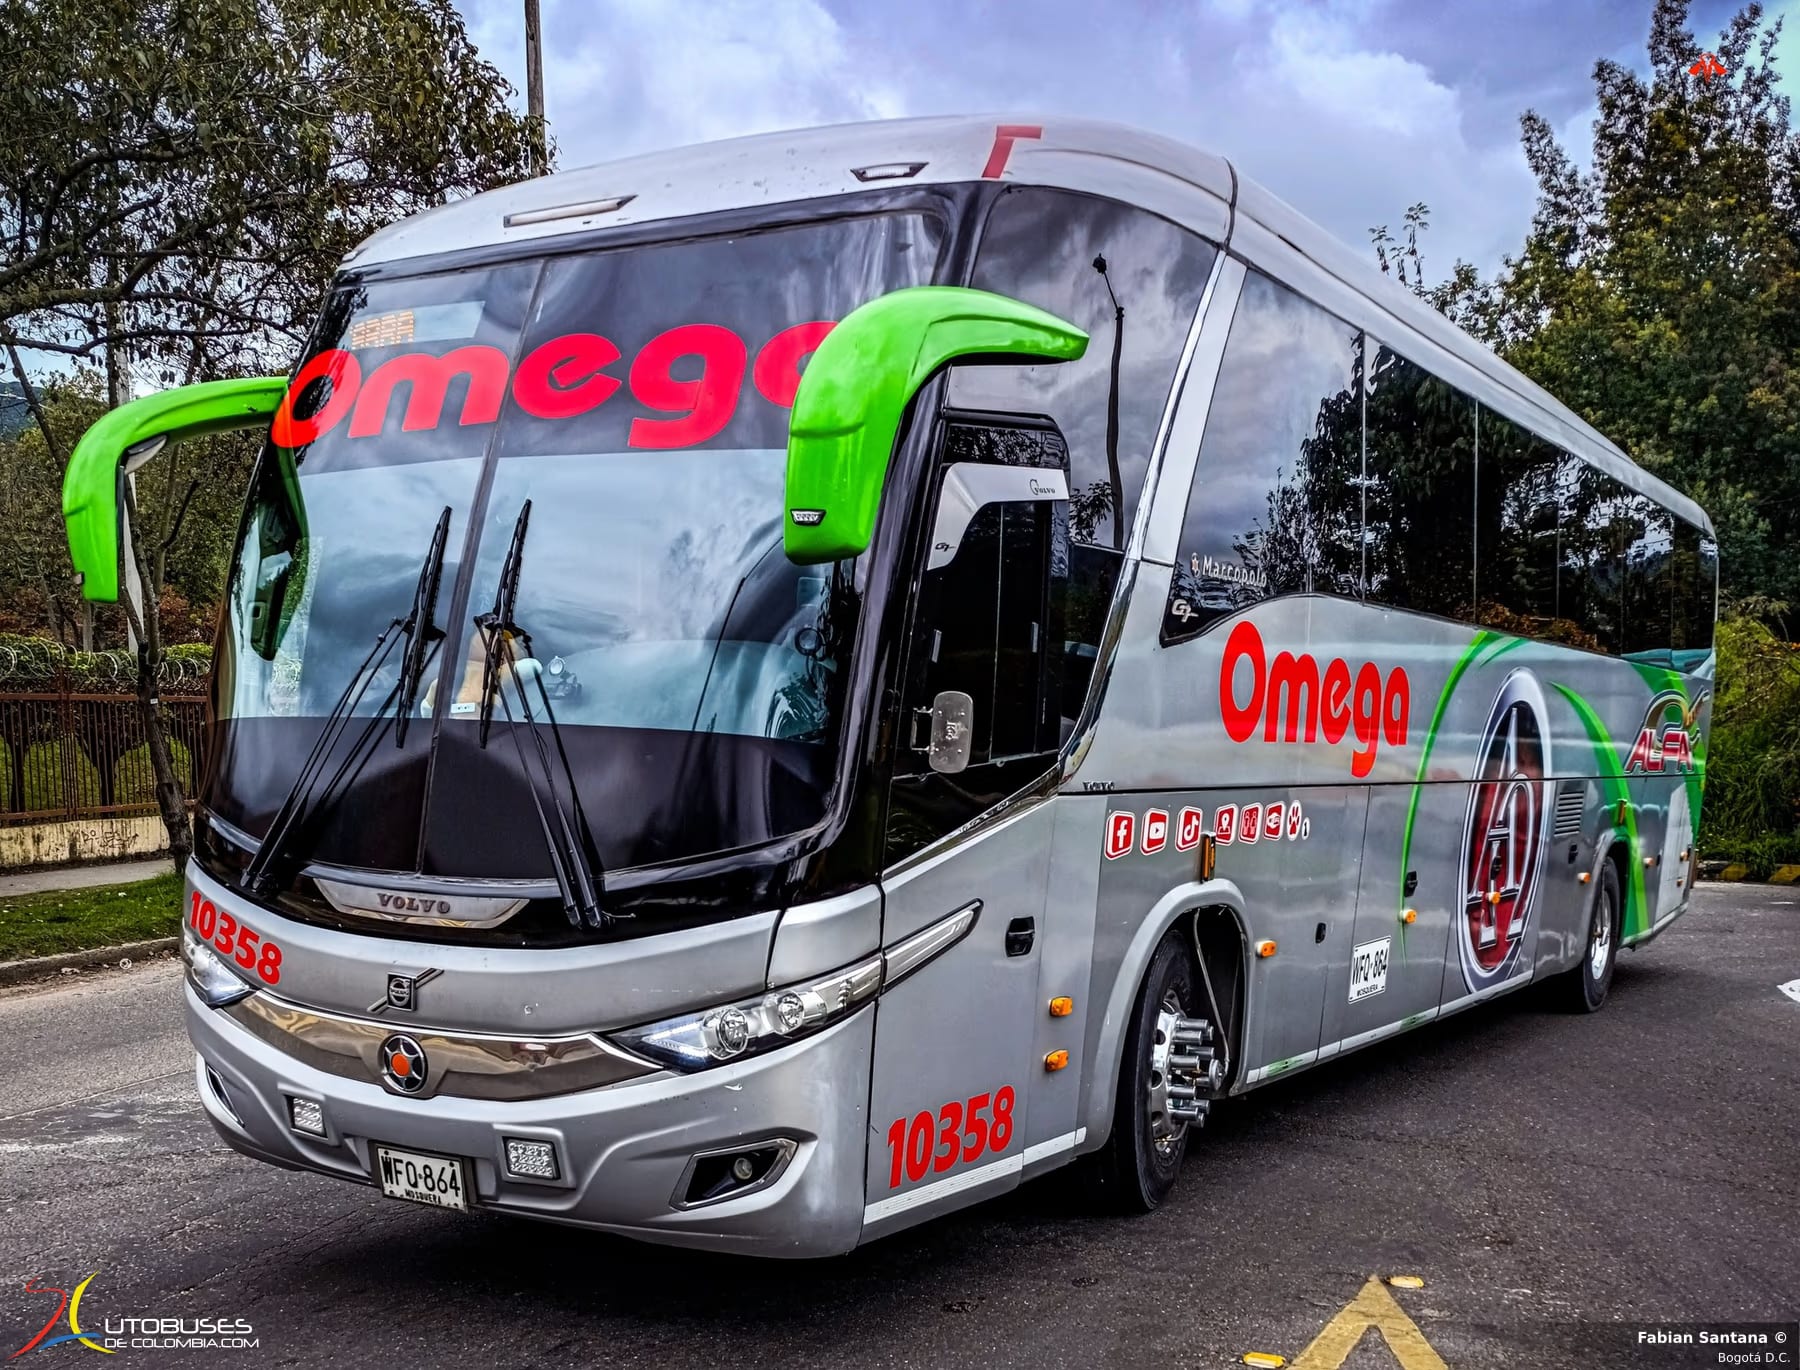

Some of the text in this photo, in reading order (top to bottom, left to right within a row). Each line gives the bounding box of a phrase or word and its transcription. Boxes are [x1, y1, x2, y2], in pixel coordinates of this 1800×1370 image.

[1202, 555, 1267, 588] Marcopolo
[1219, 620, 1411, 778] Omega
[1623, 728, 1694, 775] ALFA
[190, 890, 283, 985] 10358
[378, 893, 450, 914] VOLVO
[887, 1084, 1016, 1189] 10358
